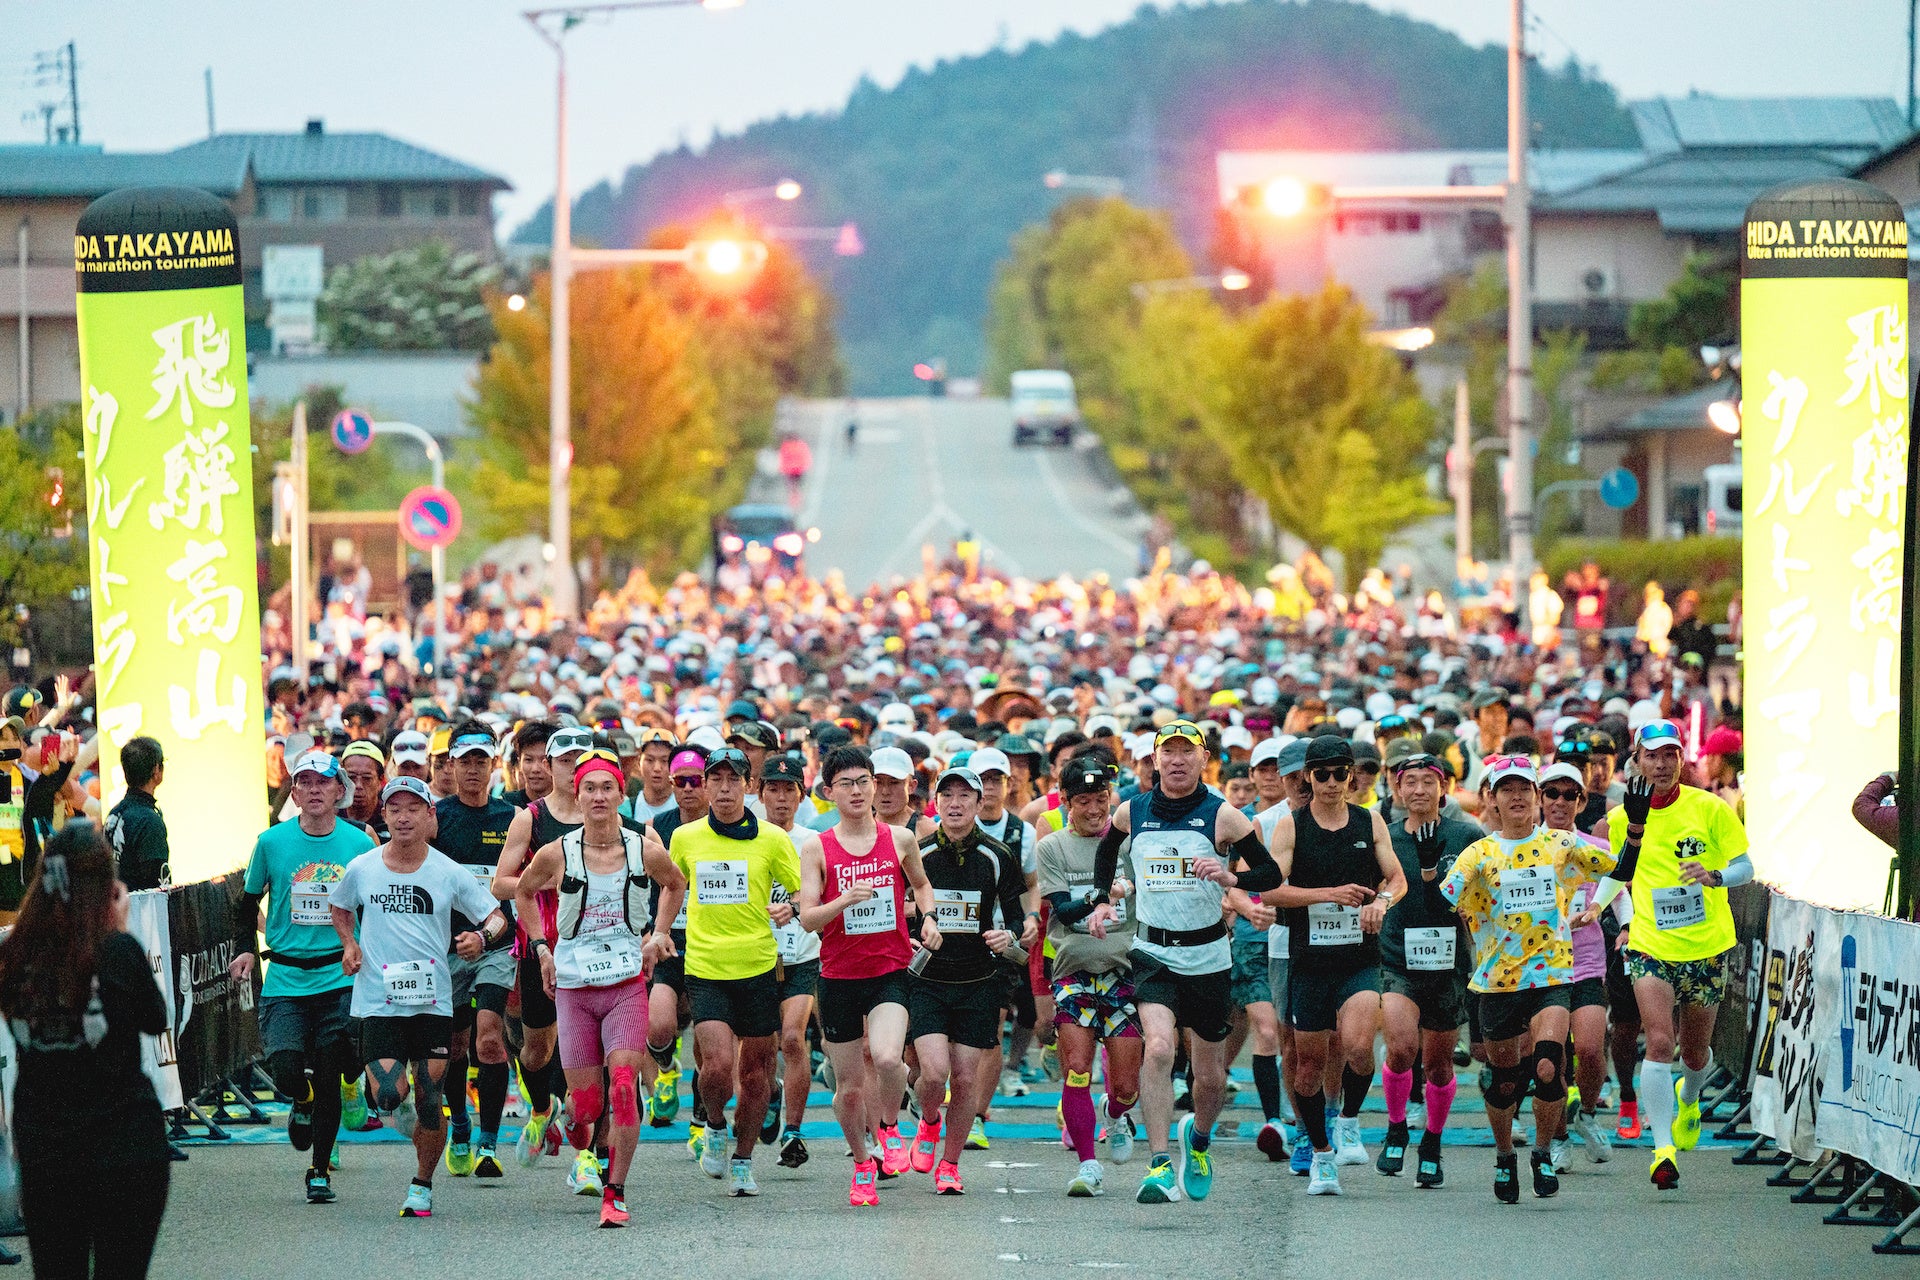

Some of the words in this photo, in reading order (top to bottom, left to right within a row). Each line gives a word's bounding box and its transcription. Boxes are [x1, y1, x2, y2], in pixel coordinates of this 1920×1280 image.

[1747, 220, 1796, 246] HIDA
[1799, 219, 1908, 245] TAKAYAM
[104, 228, 234, 259] TAKAYAMA
[1747, 245, 1772, 260] Ultra
[1773, 244, 1851, 259] marathon
[87, 258, 152, 273] marathon
[155, 252, 235, 271] tournament
[1835, 304, 1908, 728] 飛騨高山
[145, 311, 248, 741] 飛騨高山
[834, 858, 878, 885] Tajimi
[1150, 865, 1175, 873] 1793
[389, 884, 412, 894] THE
[703, 880, 727, 889] 1544
[1545, 883, 1552, 891] A
[1509, 887, 1535, 897] 1715
[370, 894, 412, 904] NORTH
[1695, 898, 1701, 906] A
[302, 900, 321, 910] 115
[382, 904, 412, 914] FACE
[886, 904, 892, 912] A
[1661, 904, 1686, 915] 1788
[851, 907, 876, 917] 1007
[969, 907, 977, 917] A
[1317, 921, 1341, 930] 1734
[1352, 918, 1358, 926] A
[787, 936, 794, 945] A
[1412, 946, 1437, 955] 1104
[1446, 944, 1452, 952] A
[622, 955, 629, 964] A
[587, 961, 613, 973] 1332
[391, 980, 417, 990] 1348
[427, 977, 433, 986] A
